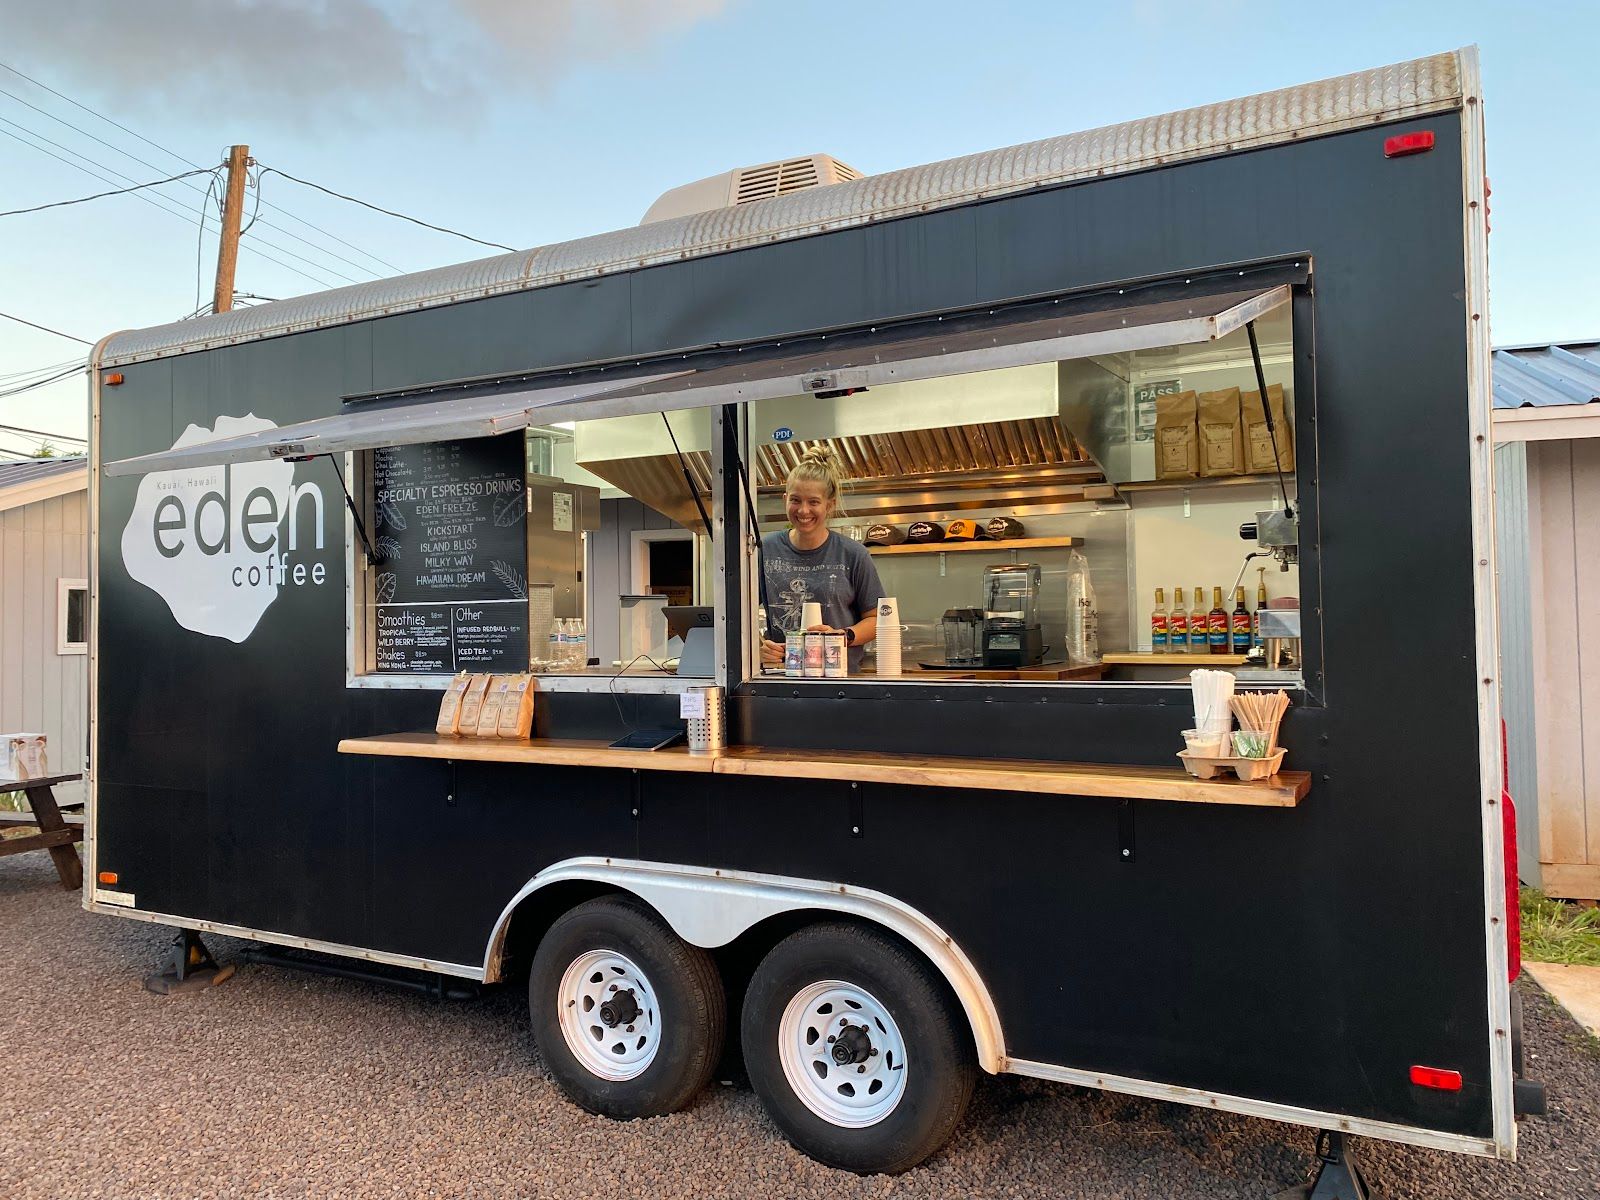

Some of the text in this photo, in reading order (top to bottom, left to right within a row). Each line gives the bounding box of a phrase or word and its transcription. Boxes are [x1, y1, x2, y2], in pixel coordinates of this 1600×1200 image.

[1141, 388, 1174, 401] PASS
[775, 431, 791, 439] PDI
[375, 470, 385, 478] Hot
[187, 475, 217, 487] Hawaii
[375, 478, 384, 486] Hot
[377, 487, 428, 503] SPECIALTY
[432, 482, 482, 498] ESPRESSO
[485, 479, 521, 495] DRINKS
[153, 464, 324, 558] eden
[416, 502, 478, 515] EDEN FREEZE
[427, 523, 474, 537] KICKSTART
[420, 538, 477, 553] ISLAND BLISS
[425, 555, 474, 568] MILKY WAY
[232, 552, 325, 586] coffee
[416, 571, 486, 586] HAWAIIAN DREAM
[377, 608, 426, 627] Smoothies
[456, 607, 483, 621] Other
[456, 626, 482, 634] INFUSED
[377, 638, 394, 647] WILD
[376, 647, 406, 660] Shakes
